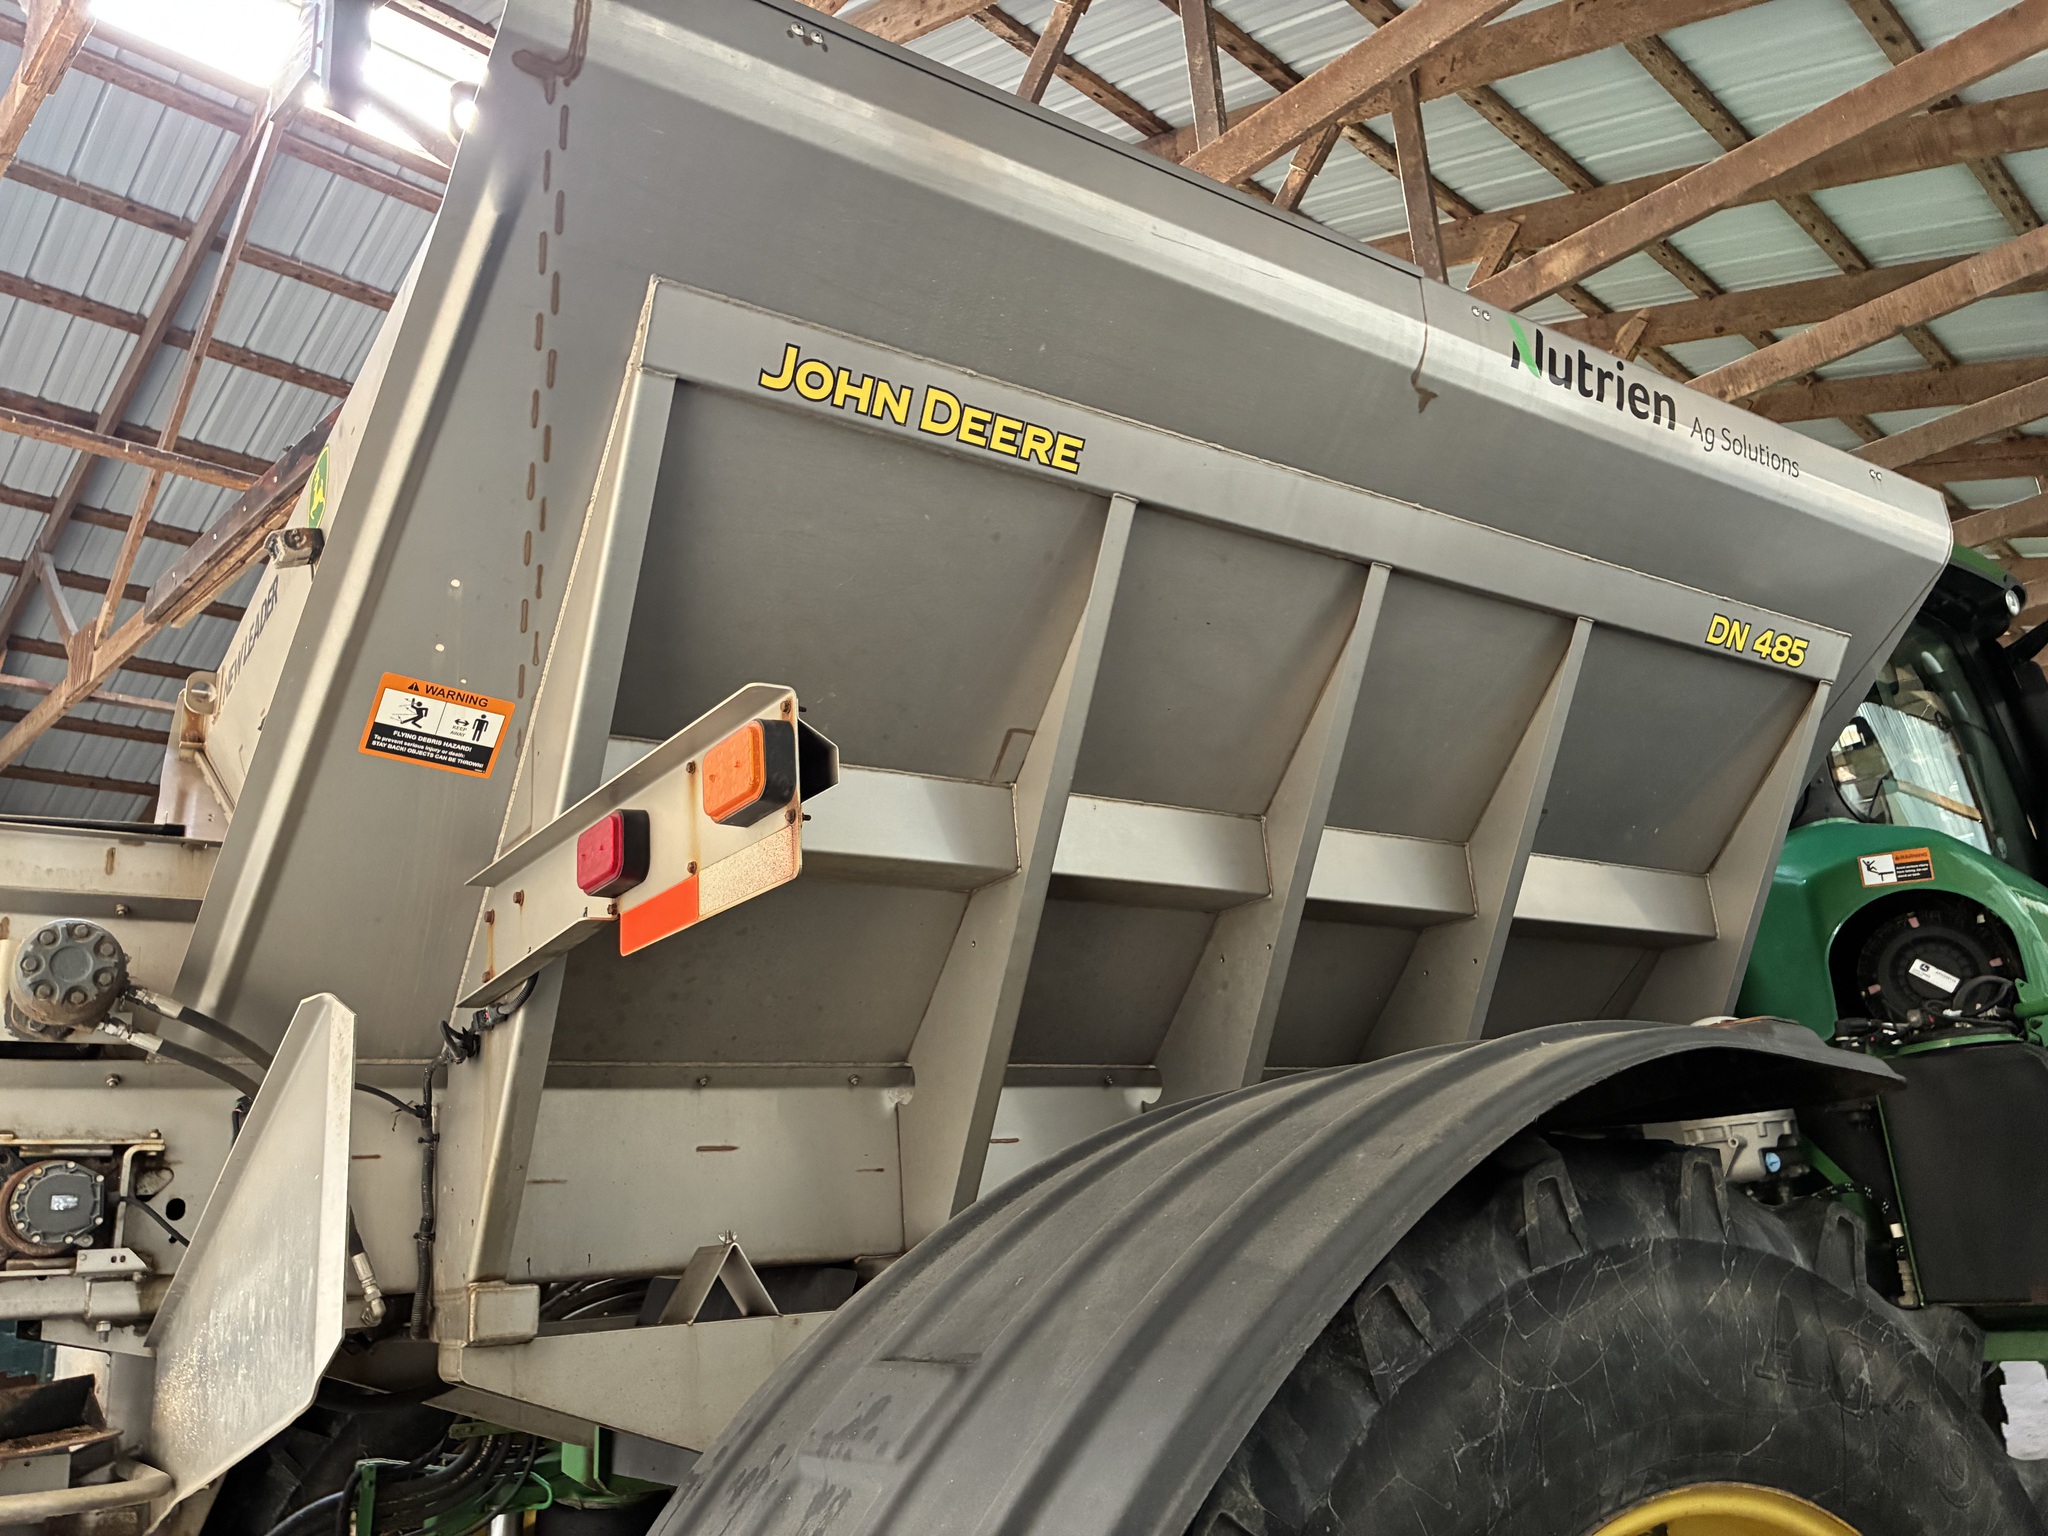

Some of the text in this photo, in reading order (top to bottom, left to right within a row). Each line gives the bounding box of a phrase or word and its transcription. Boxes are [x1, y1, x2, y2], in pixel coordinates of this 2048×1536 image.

[1506, 314, 1676, 430] Nutrien
[758, 343, 1086, 474] JOHN DEERE
[1690, 416, 1800, 479] Ag Solutions
[243, 574, 279, 666] LEADER
[1705, 613, 1810, 668] DN 485
[425, 684, 489, 708] WARNING
[371, 740, 388, 748] STAY
[407, 748, 435, 758] OBJECTS
[381, 737, 404, 746] prevent
[403, 741, 425, 749] serious
[424, 745, 441, 754] injury
[393, 730, 472, 752] FLYING DEBRIS HAZARD!
